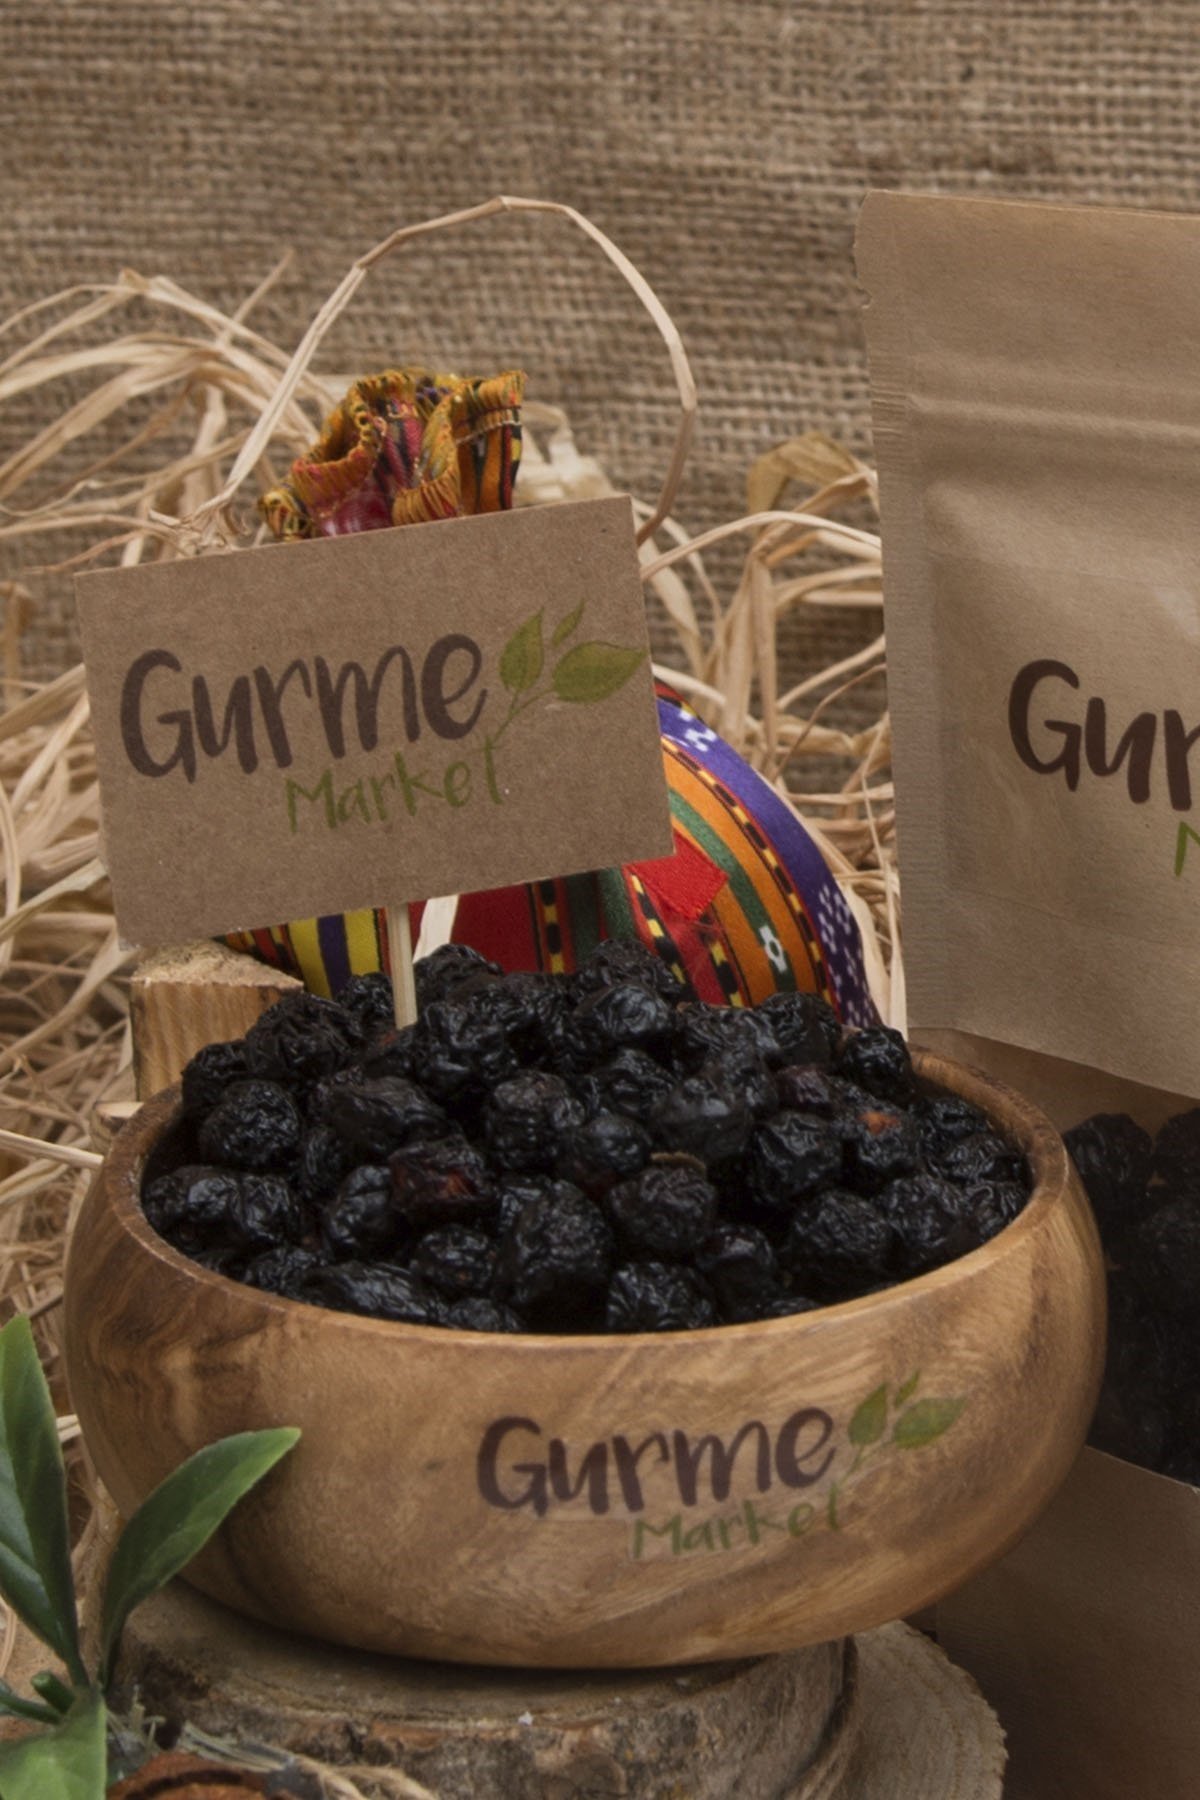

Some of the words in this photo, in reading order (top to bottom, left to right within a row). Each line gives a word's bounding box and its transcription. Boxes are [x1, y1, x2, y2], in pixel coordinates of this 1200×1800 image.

[120, 633, 488, 784] Gurme
[285, 736, 505, 834] Market
[476, 1407, 836, 1518] Gurme
[632, 1482, 841, 1559] Market
